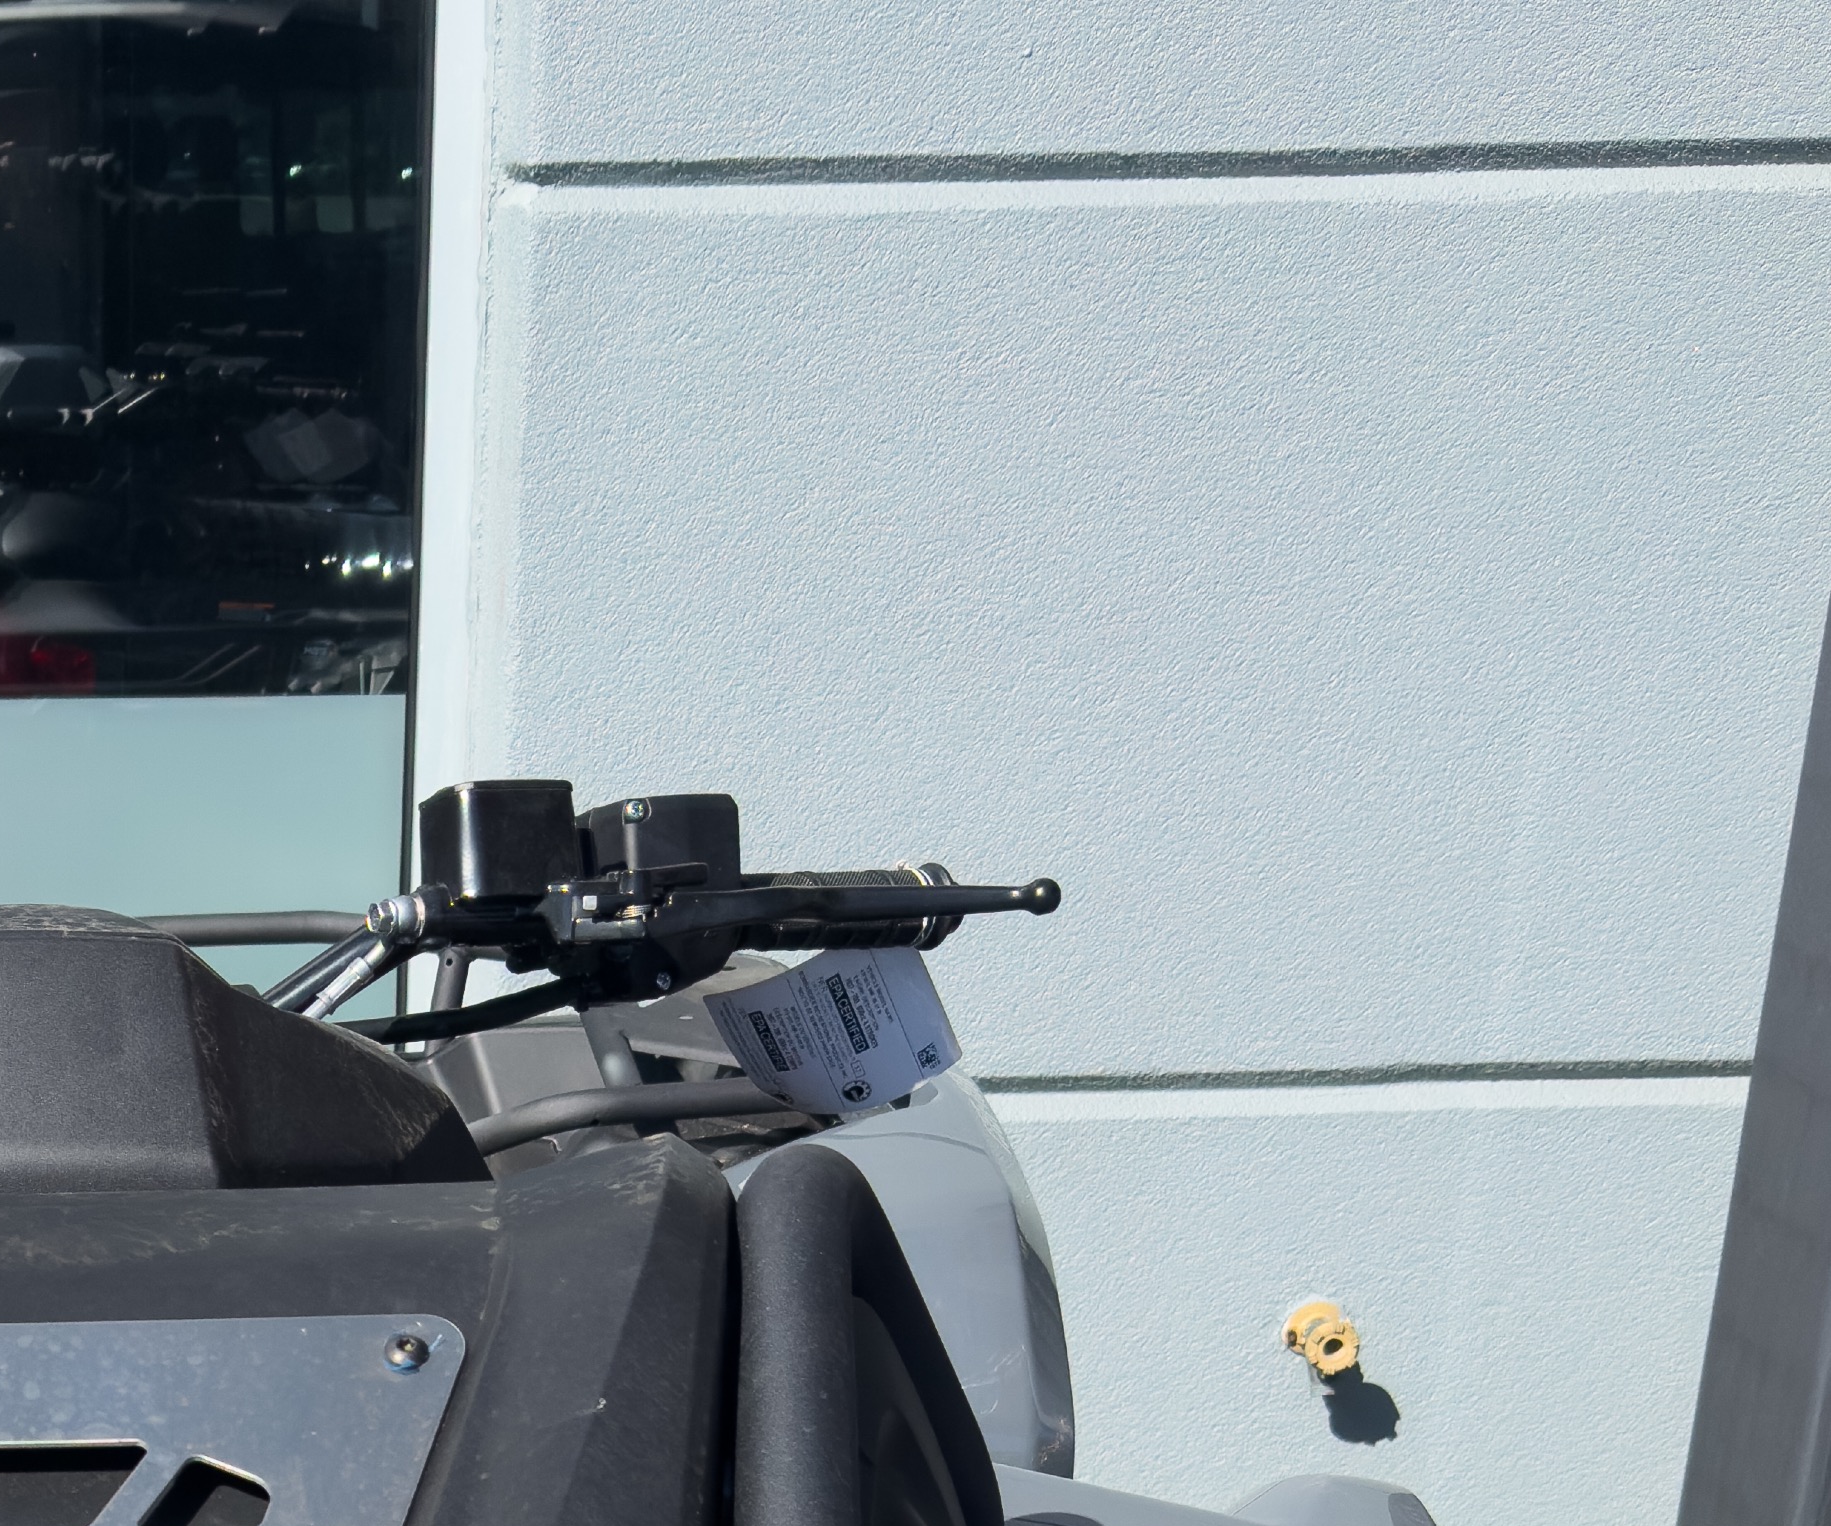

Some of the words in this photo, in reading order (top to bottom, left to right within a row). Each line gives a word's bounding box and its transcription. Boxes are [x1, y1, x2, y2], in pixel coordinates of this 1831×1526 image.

[751, 1012, 766, 1032] EPA
[829, 976, 844, 1001] EPA
[837, 998, 867, 1054] CERTIFIED
